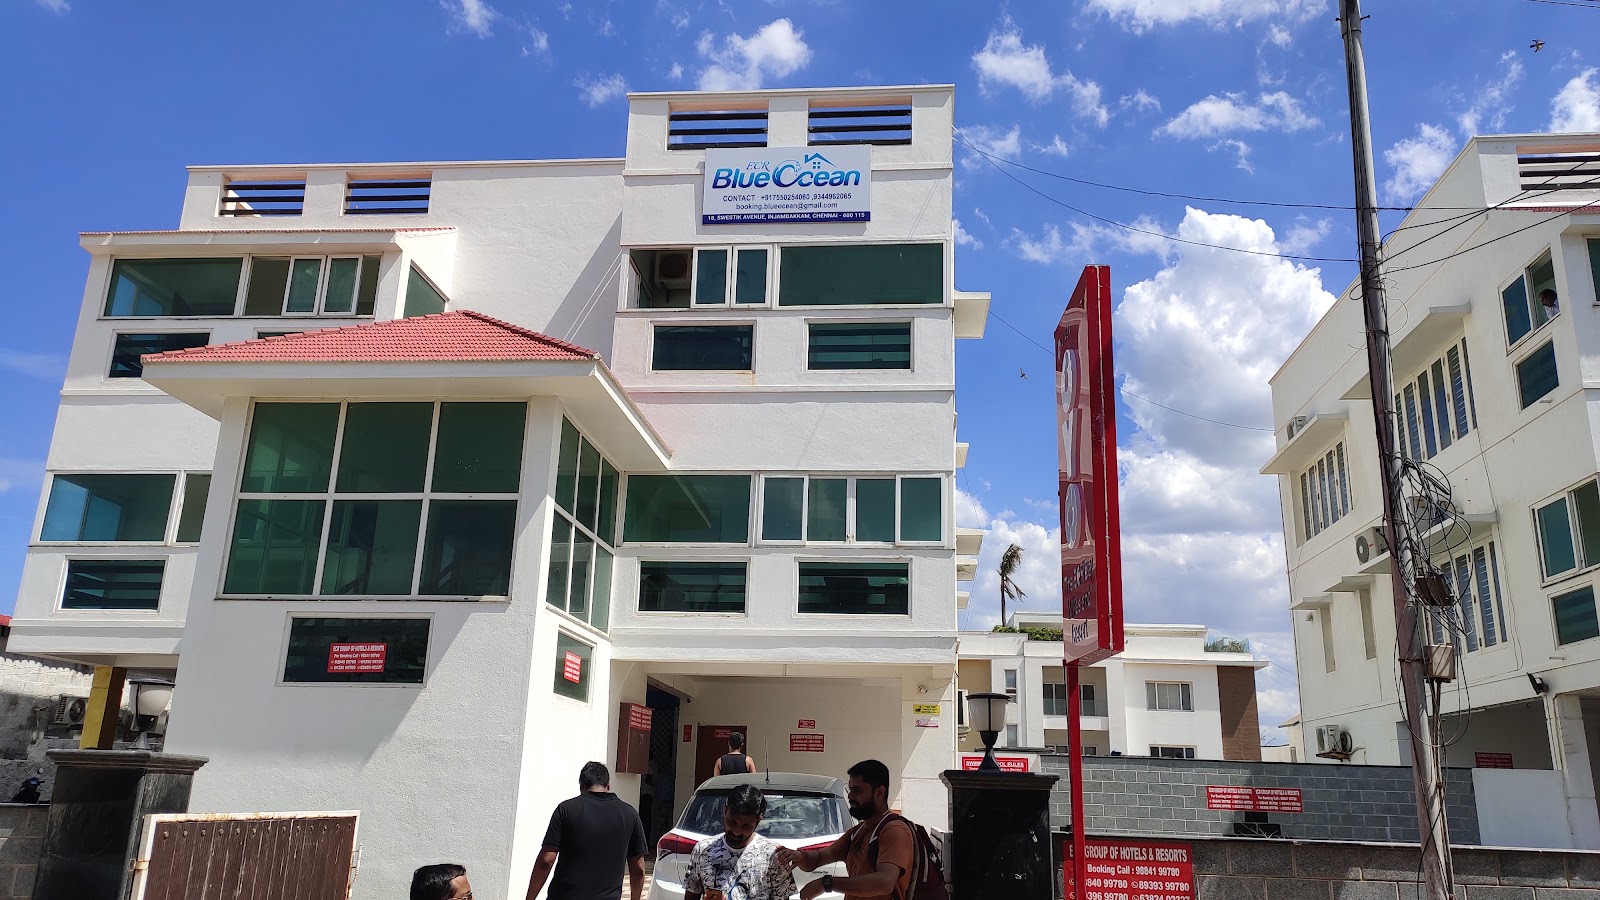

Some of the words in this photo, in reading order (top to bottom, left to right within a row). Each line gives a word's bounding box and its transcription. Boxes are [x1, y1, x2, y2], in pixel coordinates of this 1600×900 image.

[746, 161, 770, 171] ECR
[736, 202, 838, 211] booking.blueocean@gmail.com
[1084, 845, 1108, 859] GROUP
[1109, 846, 1119, 860] OF
[1120, 847, 1147, 860] HOTELS
[1148, 848, 1154, 861] &
[1155, 848, 1188, 862] RESORTS
[1087, 864, 1116, 875] Booking
[1116, 865, 1130, 874] Call
[1135, 865, 1157, 876] 98841
[1158, 867, 1180, 877] 99780
[1103, 879, 1128, 889] 99780
[1139, 880, 1163, 890] 89393
[1165, 882, 1190, 892] 99780
